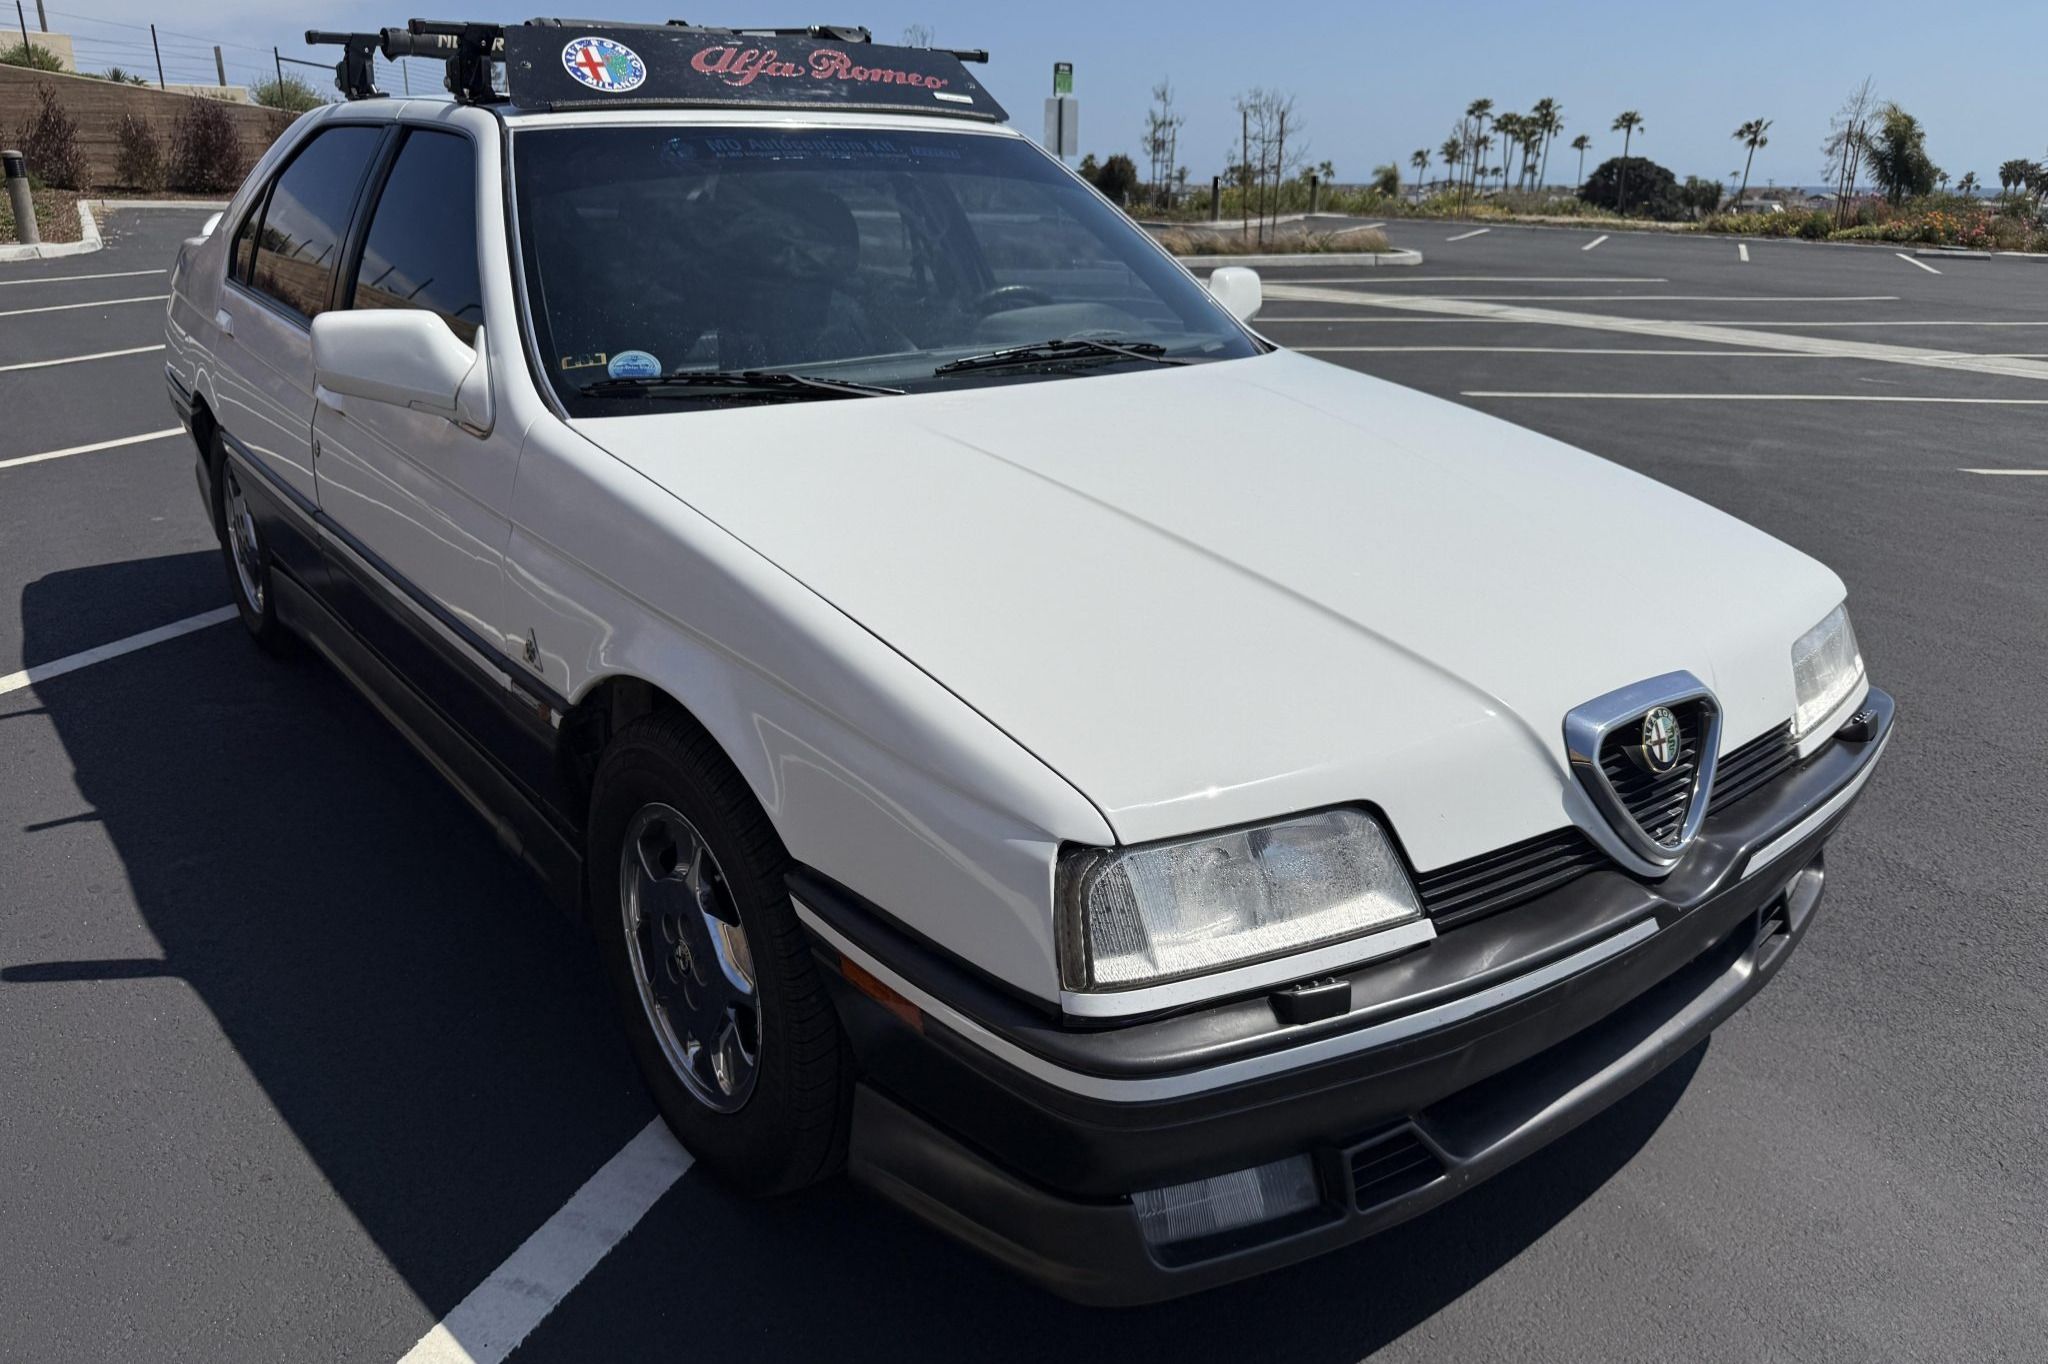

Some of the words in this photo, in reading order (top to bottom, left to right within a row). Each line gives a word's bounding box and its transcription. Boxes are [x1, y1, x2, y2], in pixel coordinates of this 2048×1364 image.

[565, 42, 584, 68] ALFA
[690, 46, 805, 86] Alfa
[808, 49, 948, 89] Romeo
[584, 76, 639, 90] MILANO
